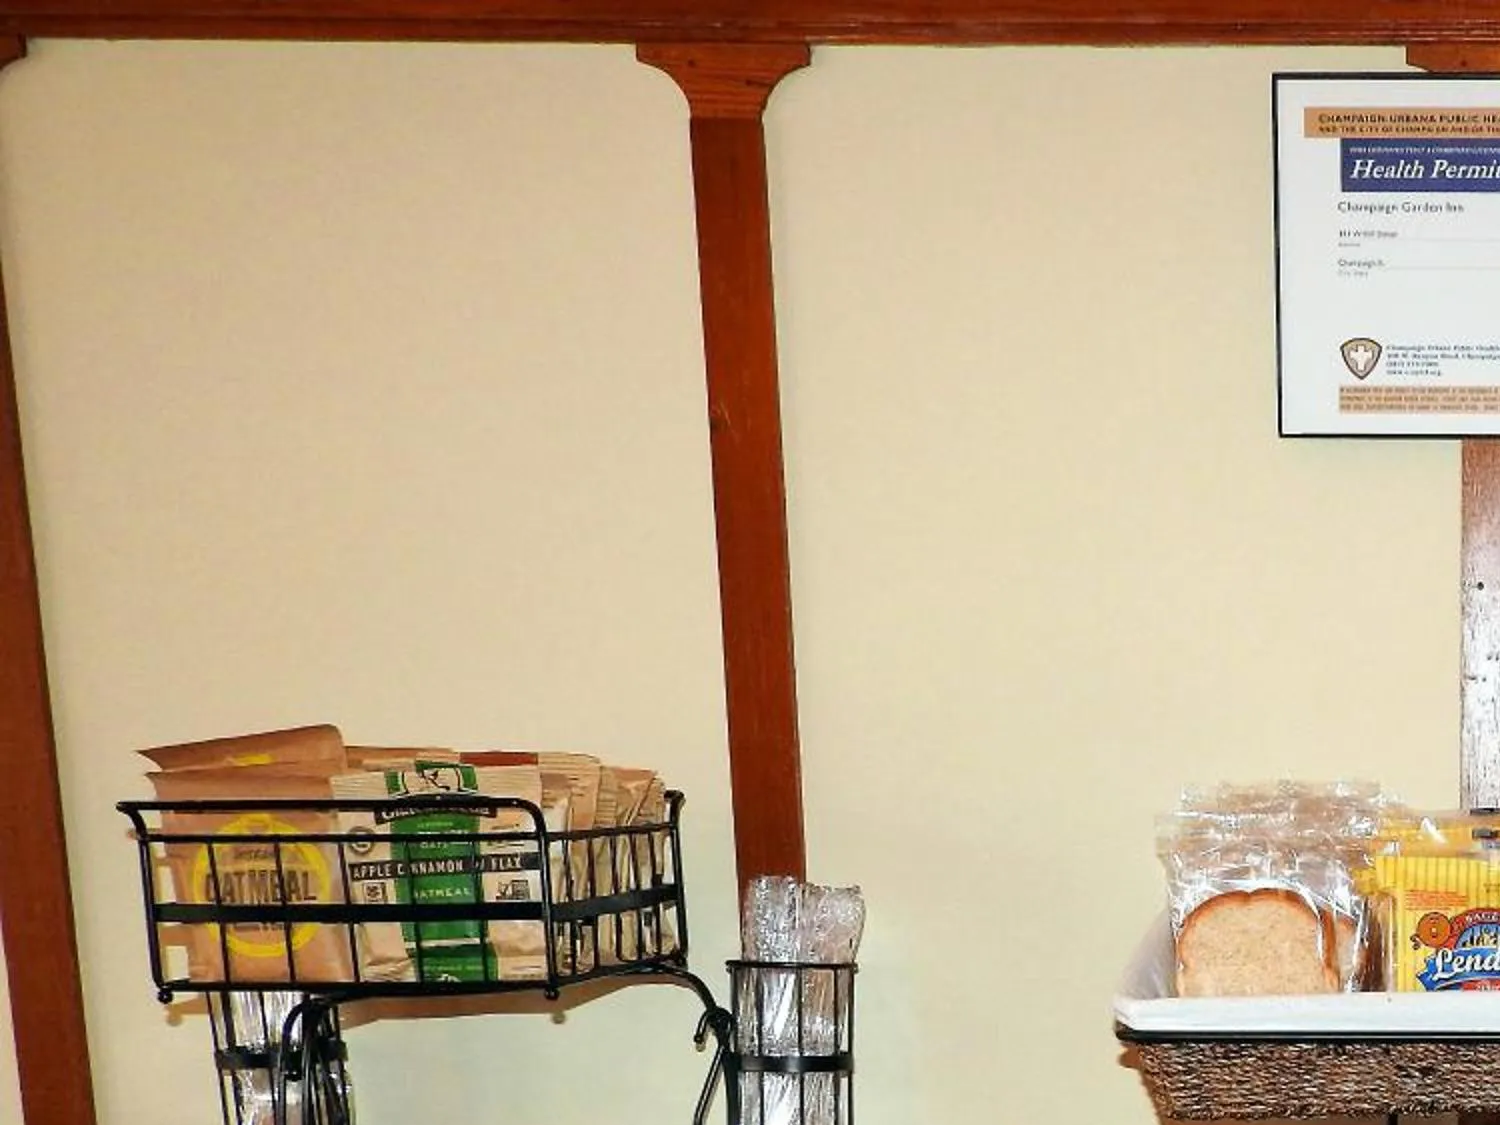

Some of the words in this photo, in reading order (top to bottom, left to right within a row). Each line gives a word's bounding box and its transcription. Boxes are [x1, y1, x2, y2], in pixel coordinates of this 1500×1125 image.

[1439, 114, 1479, 124] PUBLIC
[1350, 159, 1425, 179] Health
[353, 865, 392, 879] APPLE
[397, 859, 464, 876] CNNAMON
[414, 887, 470, 899] ATMEAL
